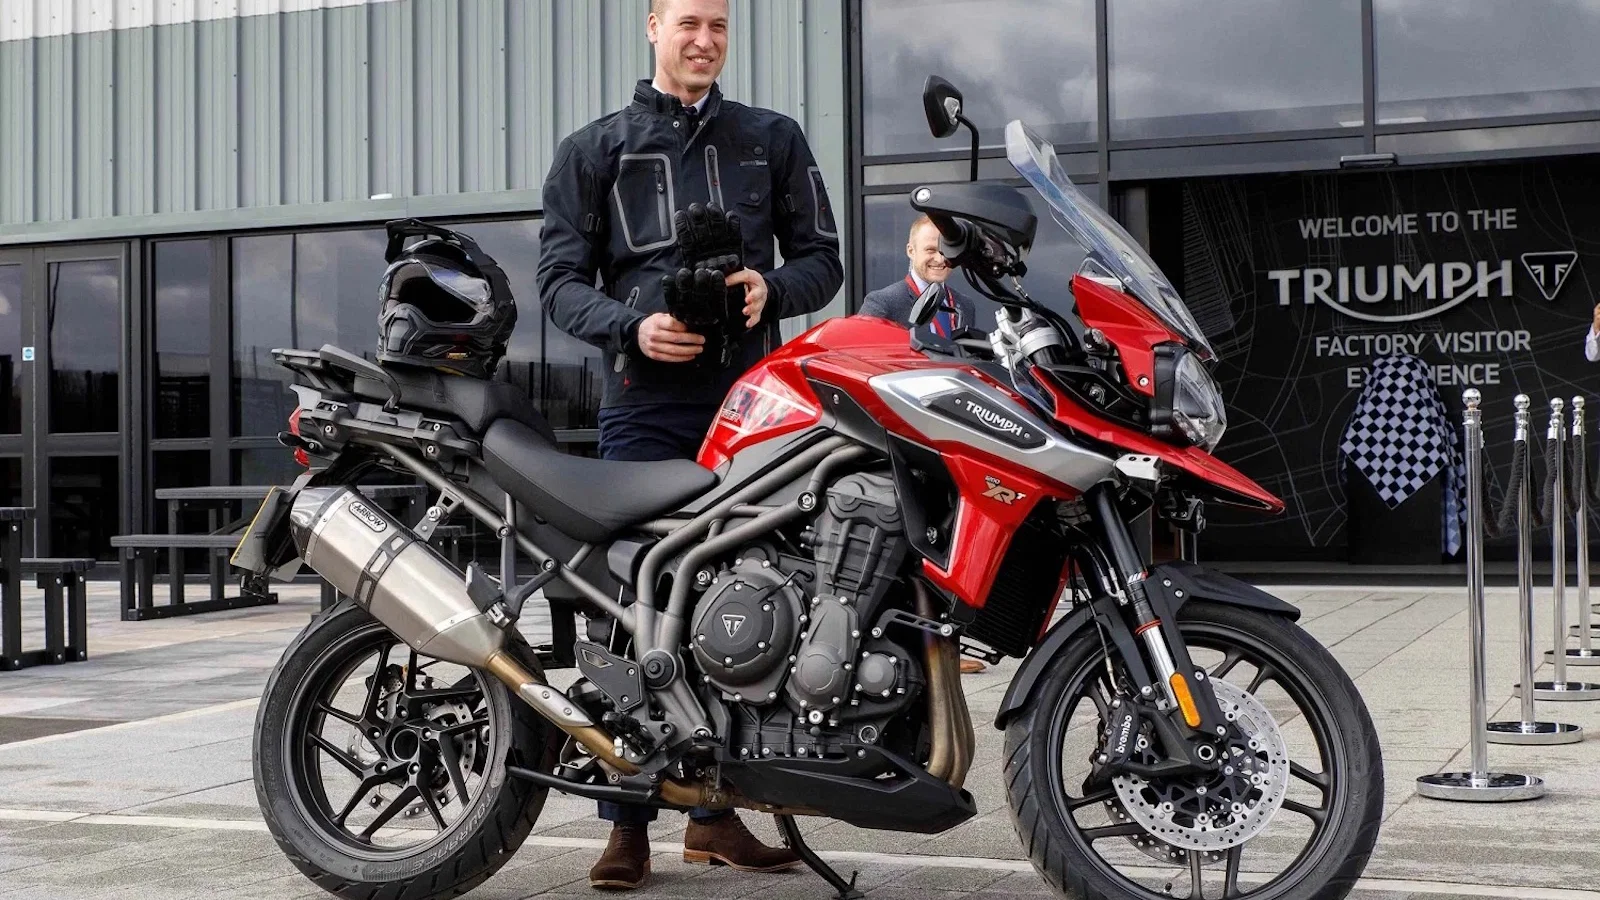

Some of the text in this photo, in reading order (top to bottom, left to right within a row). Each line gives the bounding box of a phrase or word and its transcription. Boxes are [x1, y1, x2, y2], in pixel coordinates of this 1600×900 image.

[1299, 207, 1518, 240] WELCOME TO THE
[1267, 259, 1513, 322] TRIUMPH
[1315, 329, 1532, 357] FACTORY VISITOR
[965, 400, 1023, 436] TRIUMPH
[1115, 715, 1132, 754] brembo
